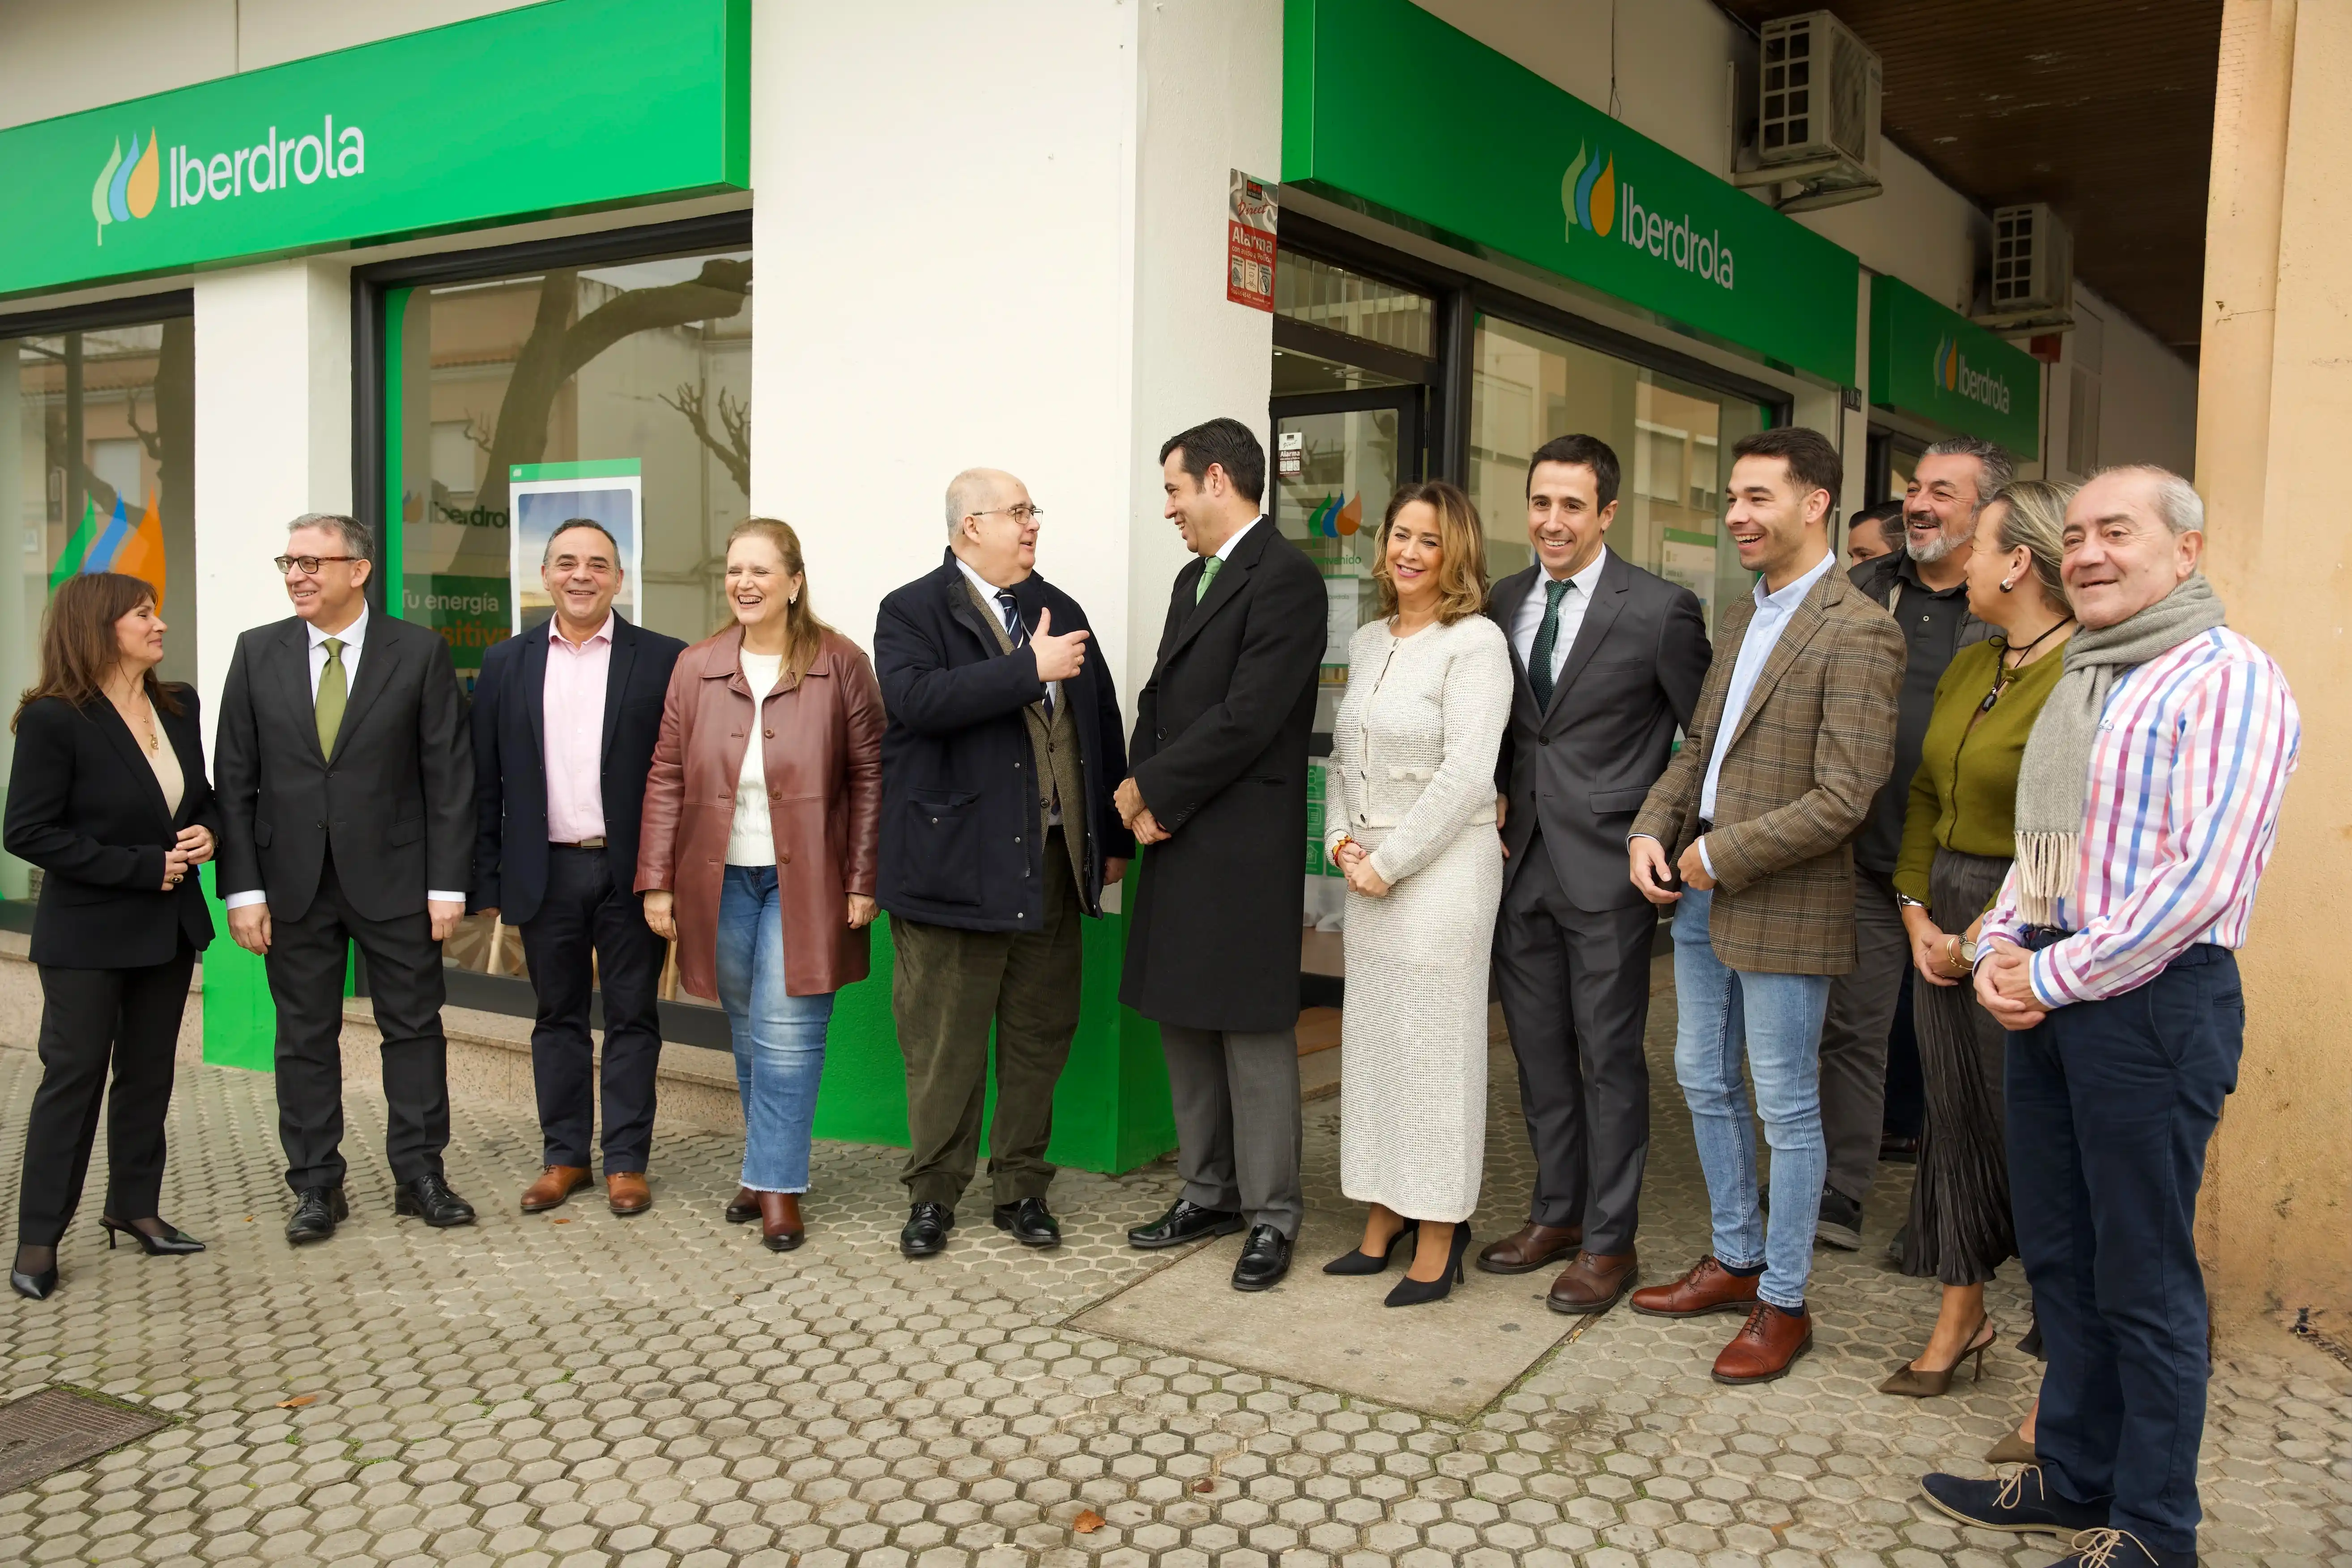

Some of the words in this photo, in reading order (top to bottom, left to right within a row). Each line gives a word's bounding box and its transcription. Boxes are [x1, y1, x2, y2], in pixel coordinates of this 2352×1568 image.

[170, 115, 365, 208] Iberdrola
[1238, 199, 1270, 217] Direct
[1232, 226, 1272, 254] Alarma
[1622, 182, 1734, 290] Iberdrola
[1241, 247, 1253, 257] aviso
[1959, 354, 2010, 414] Iberdrola
[428, 501, 510, 528] Iberdrol
[402, 589, 420, 609] Tu
[424, 592, 499, 616] energía
